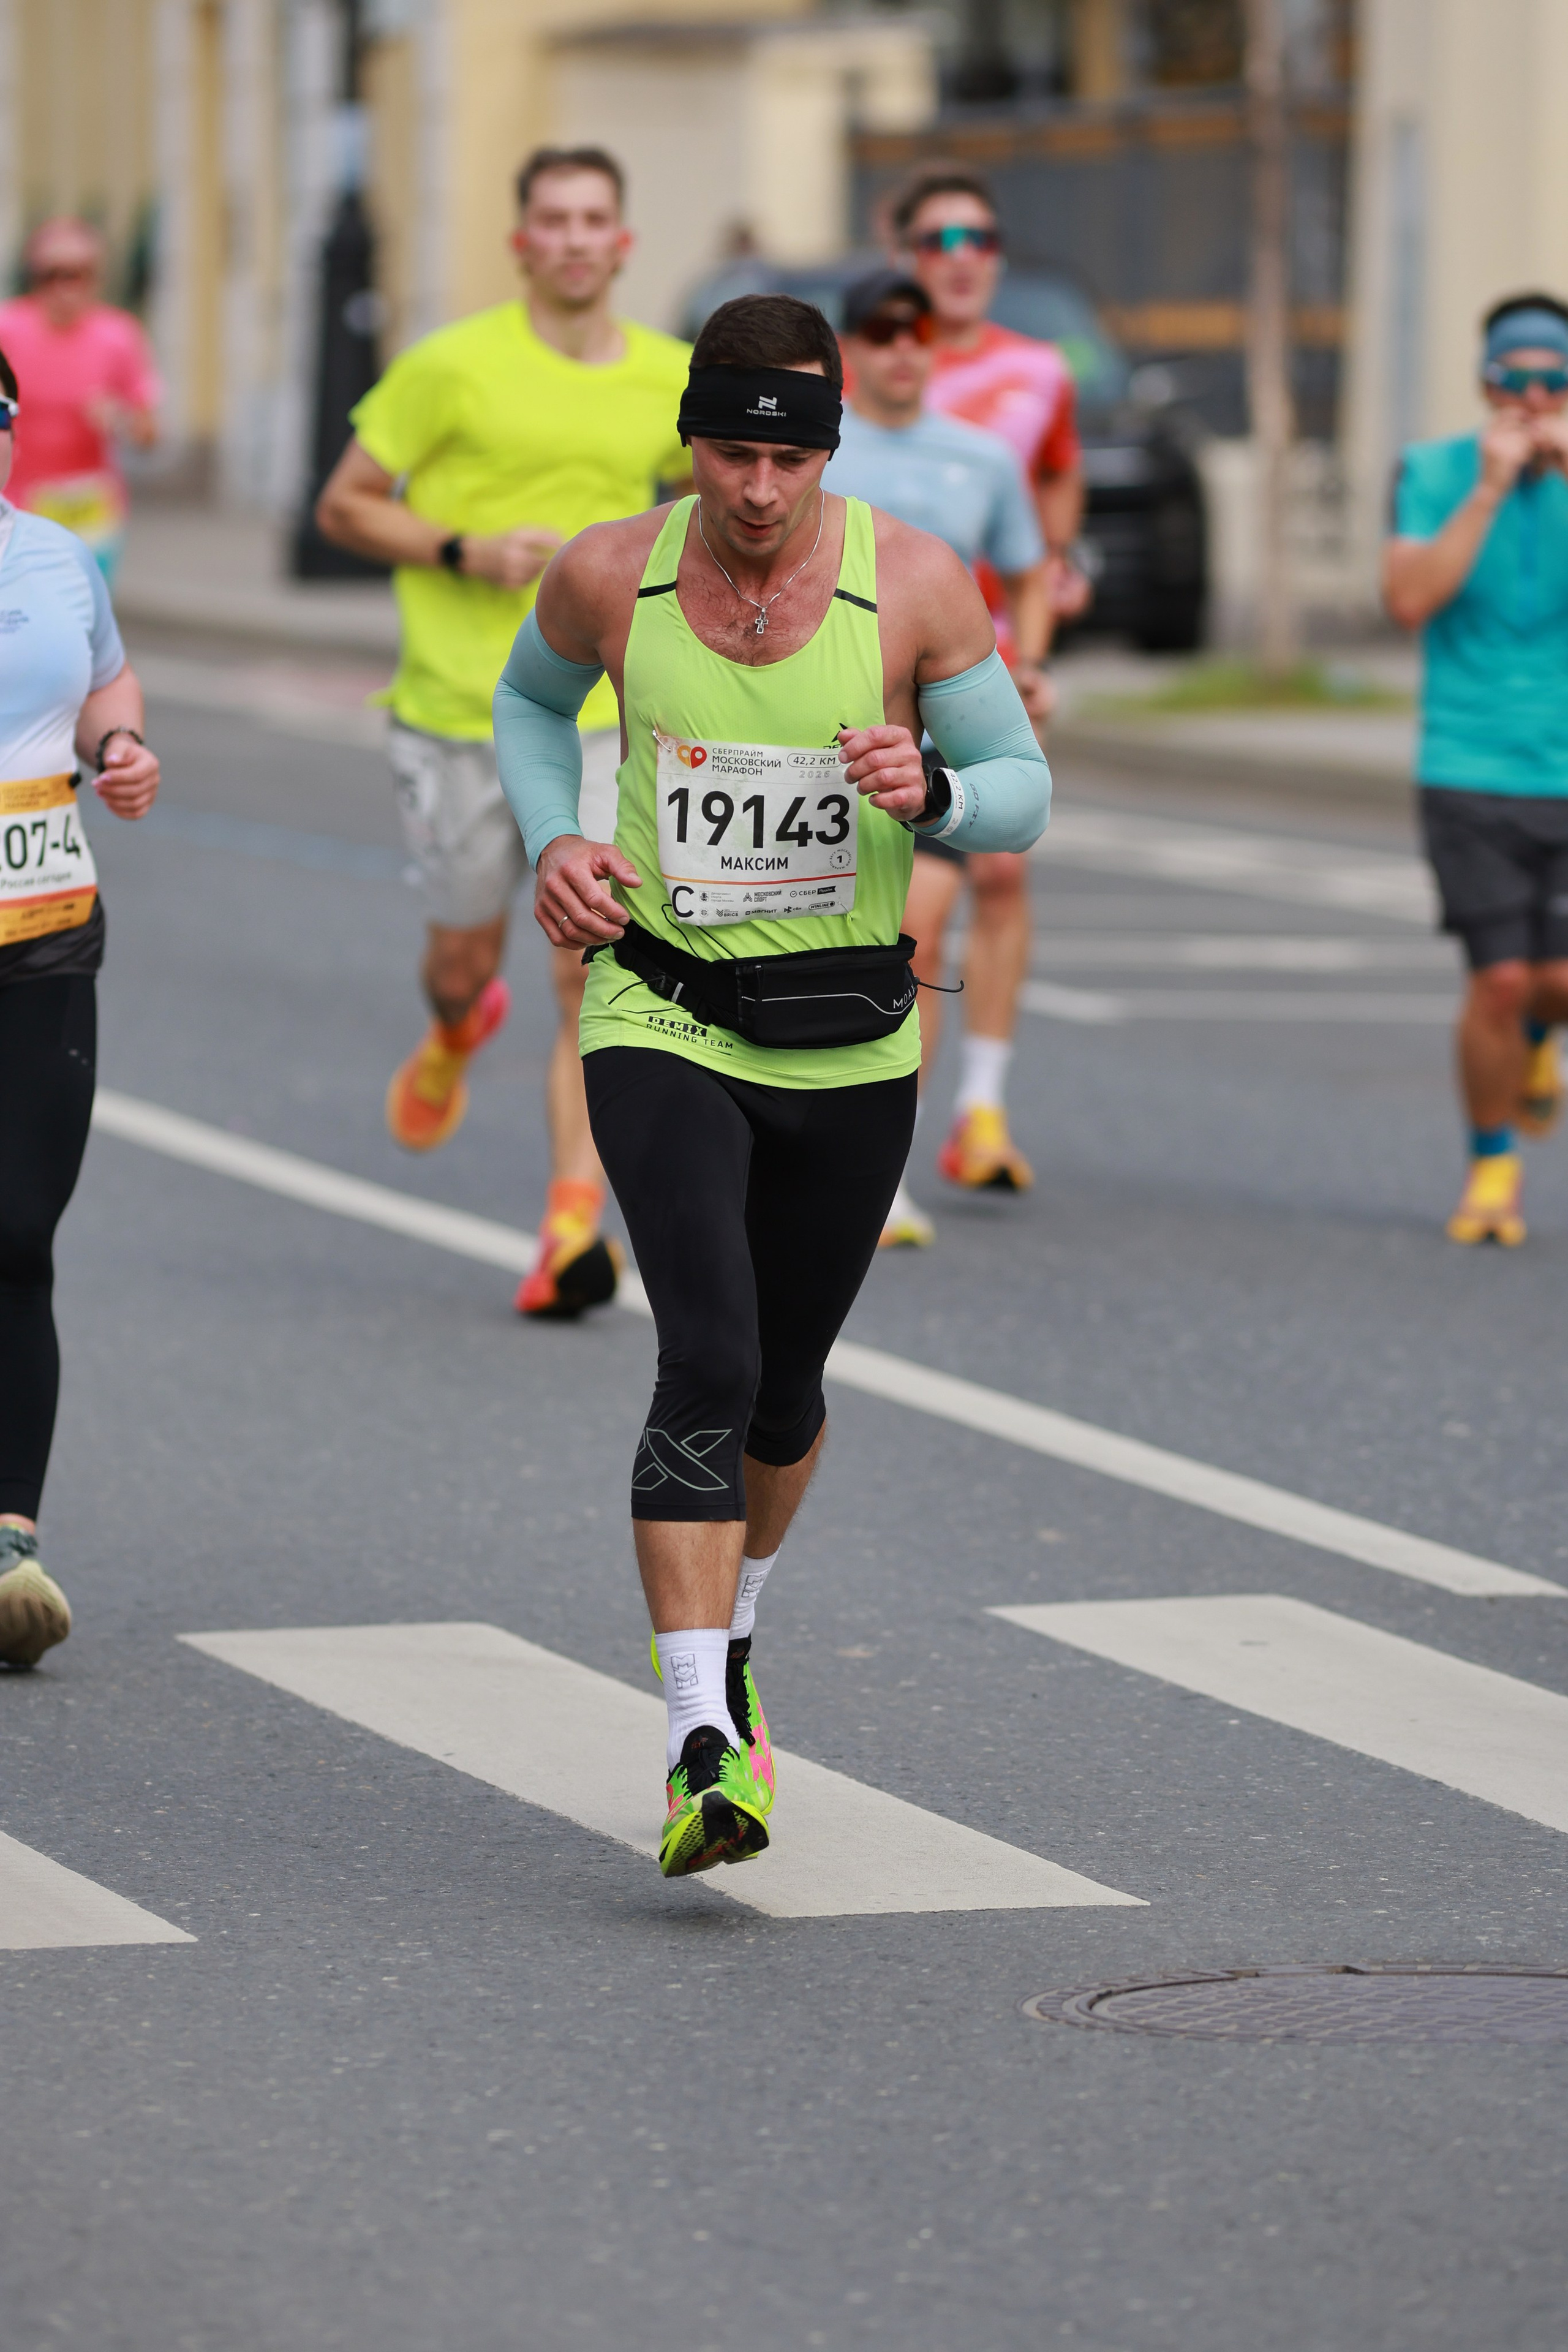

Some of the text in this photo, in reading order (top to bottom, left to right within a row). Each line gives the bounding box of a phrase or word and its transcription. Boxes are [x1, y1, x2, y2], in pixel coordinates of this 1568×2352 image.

[746, 408, 786, 417] NORDSKI
[712, 748, 763, 758] СБЕРПРАЙМ
[712, 755, 782, 768] МОСКОВСКИЙ
[793, 756, 816, 766] 42,2
[712, 764, 763, 775] МАРАФОН
[799, 770, 830, 778] 2026
[668, 787, 850, 849] 19143
[0, 814, 81, 870] 07-4
[720, 856, 788, 871] МАКСИМ
[652, 1017, 703, 1036] DEMIX
[647, 1023, 733, 1049] RUNNING TEAM
